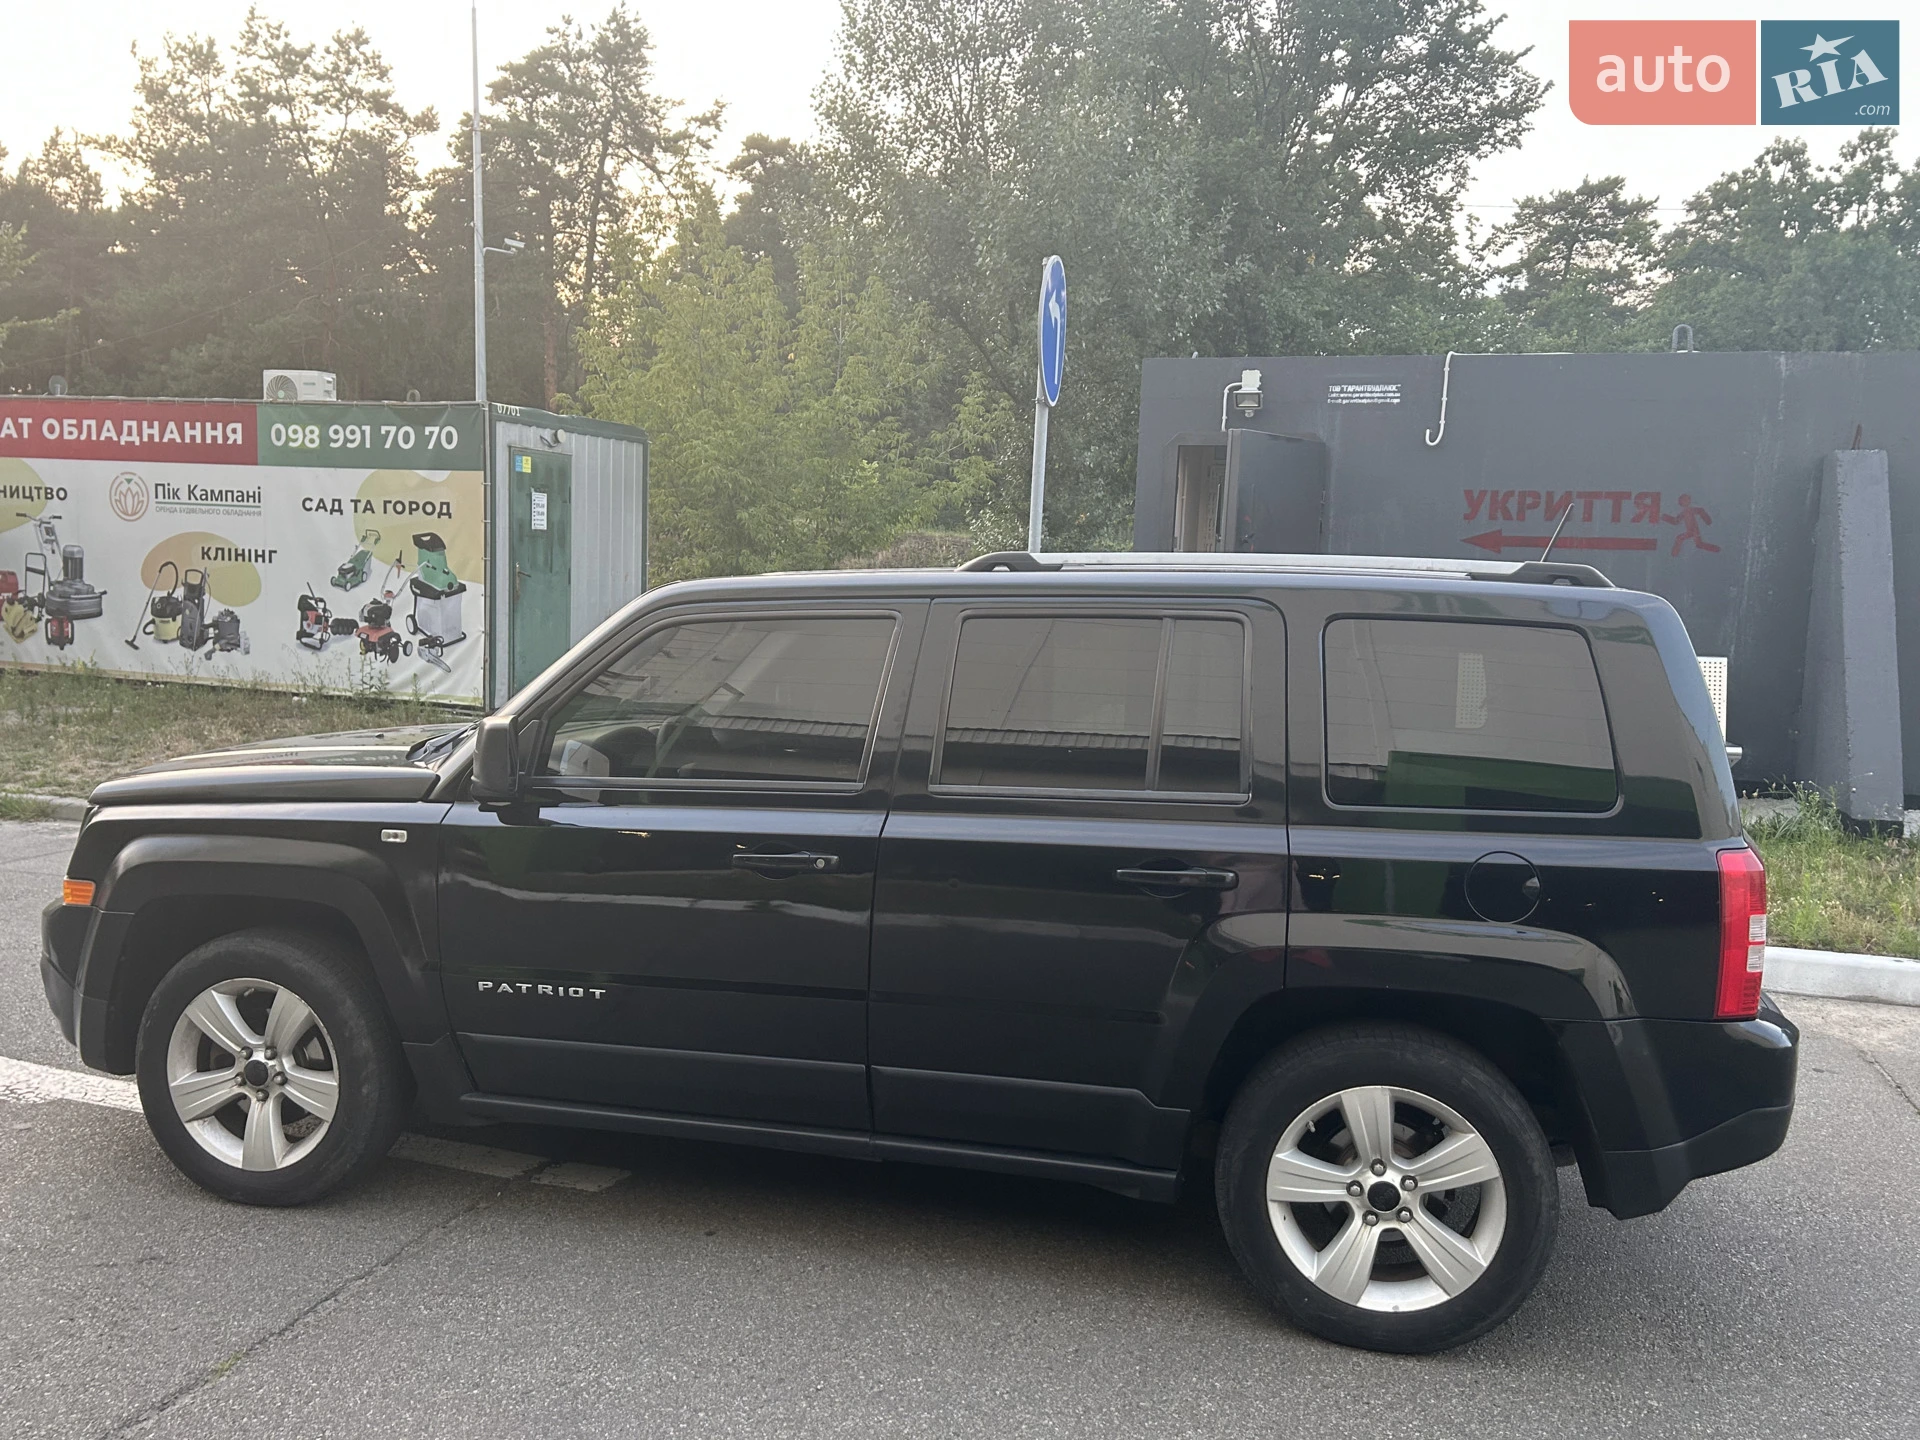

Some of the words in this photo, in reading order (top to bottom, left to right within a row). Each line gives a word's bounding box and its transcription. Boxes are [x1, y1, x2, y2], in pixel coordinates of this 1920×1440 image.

[41, 417, 243, 446] ОБЛАДНАННЯ
[270, 423, 320, 448] 098
[328, 424, 371, 449] 991
[380, 425, 416, 450] 70
[424, 425, 459, 450] 70
[154, 482, 181, 500] Пік
[187, 484, 262, 504] Кампані
[301, 497, 344, 515] САД
[350, 499, 375, 514] ТА
[383, 500, 452, 519] ГОРОД
[1463, 489, 1662, 524] УКРИТТЯ
[201, 546, 278, 564] КЛІНІНГ
[477, 981, 607, 1000] PATRIOT
